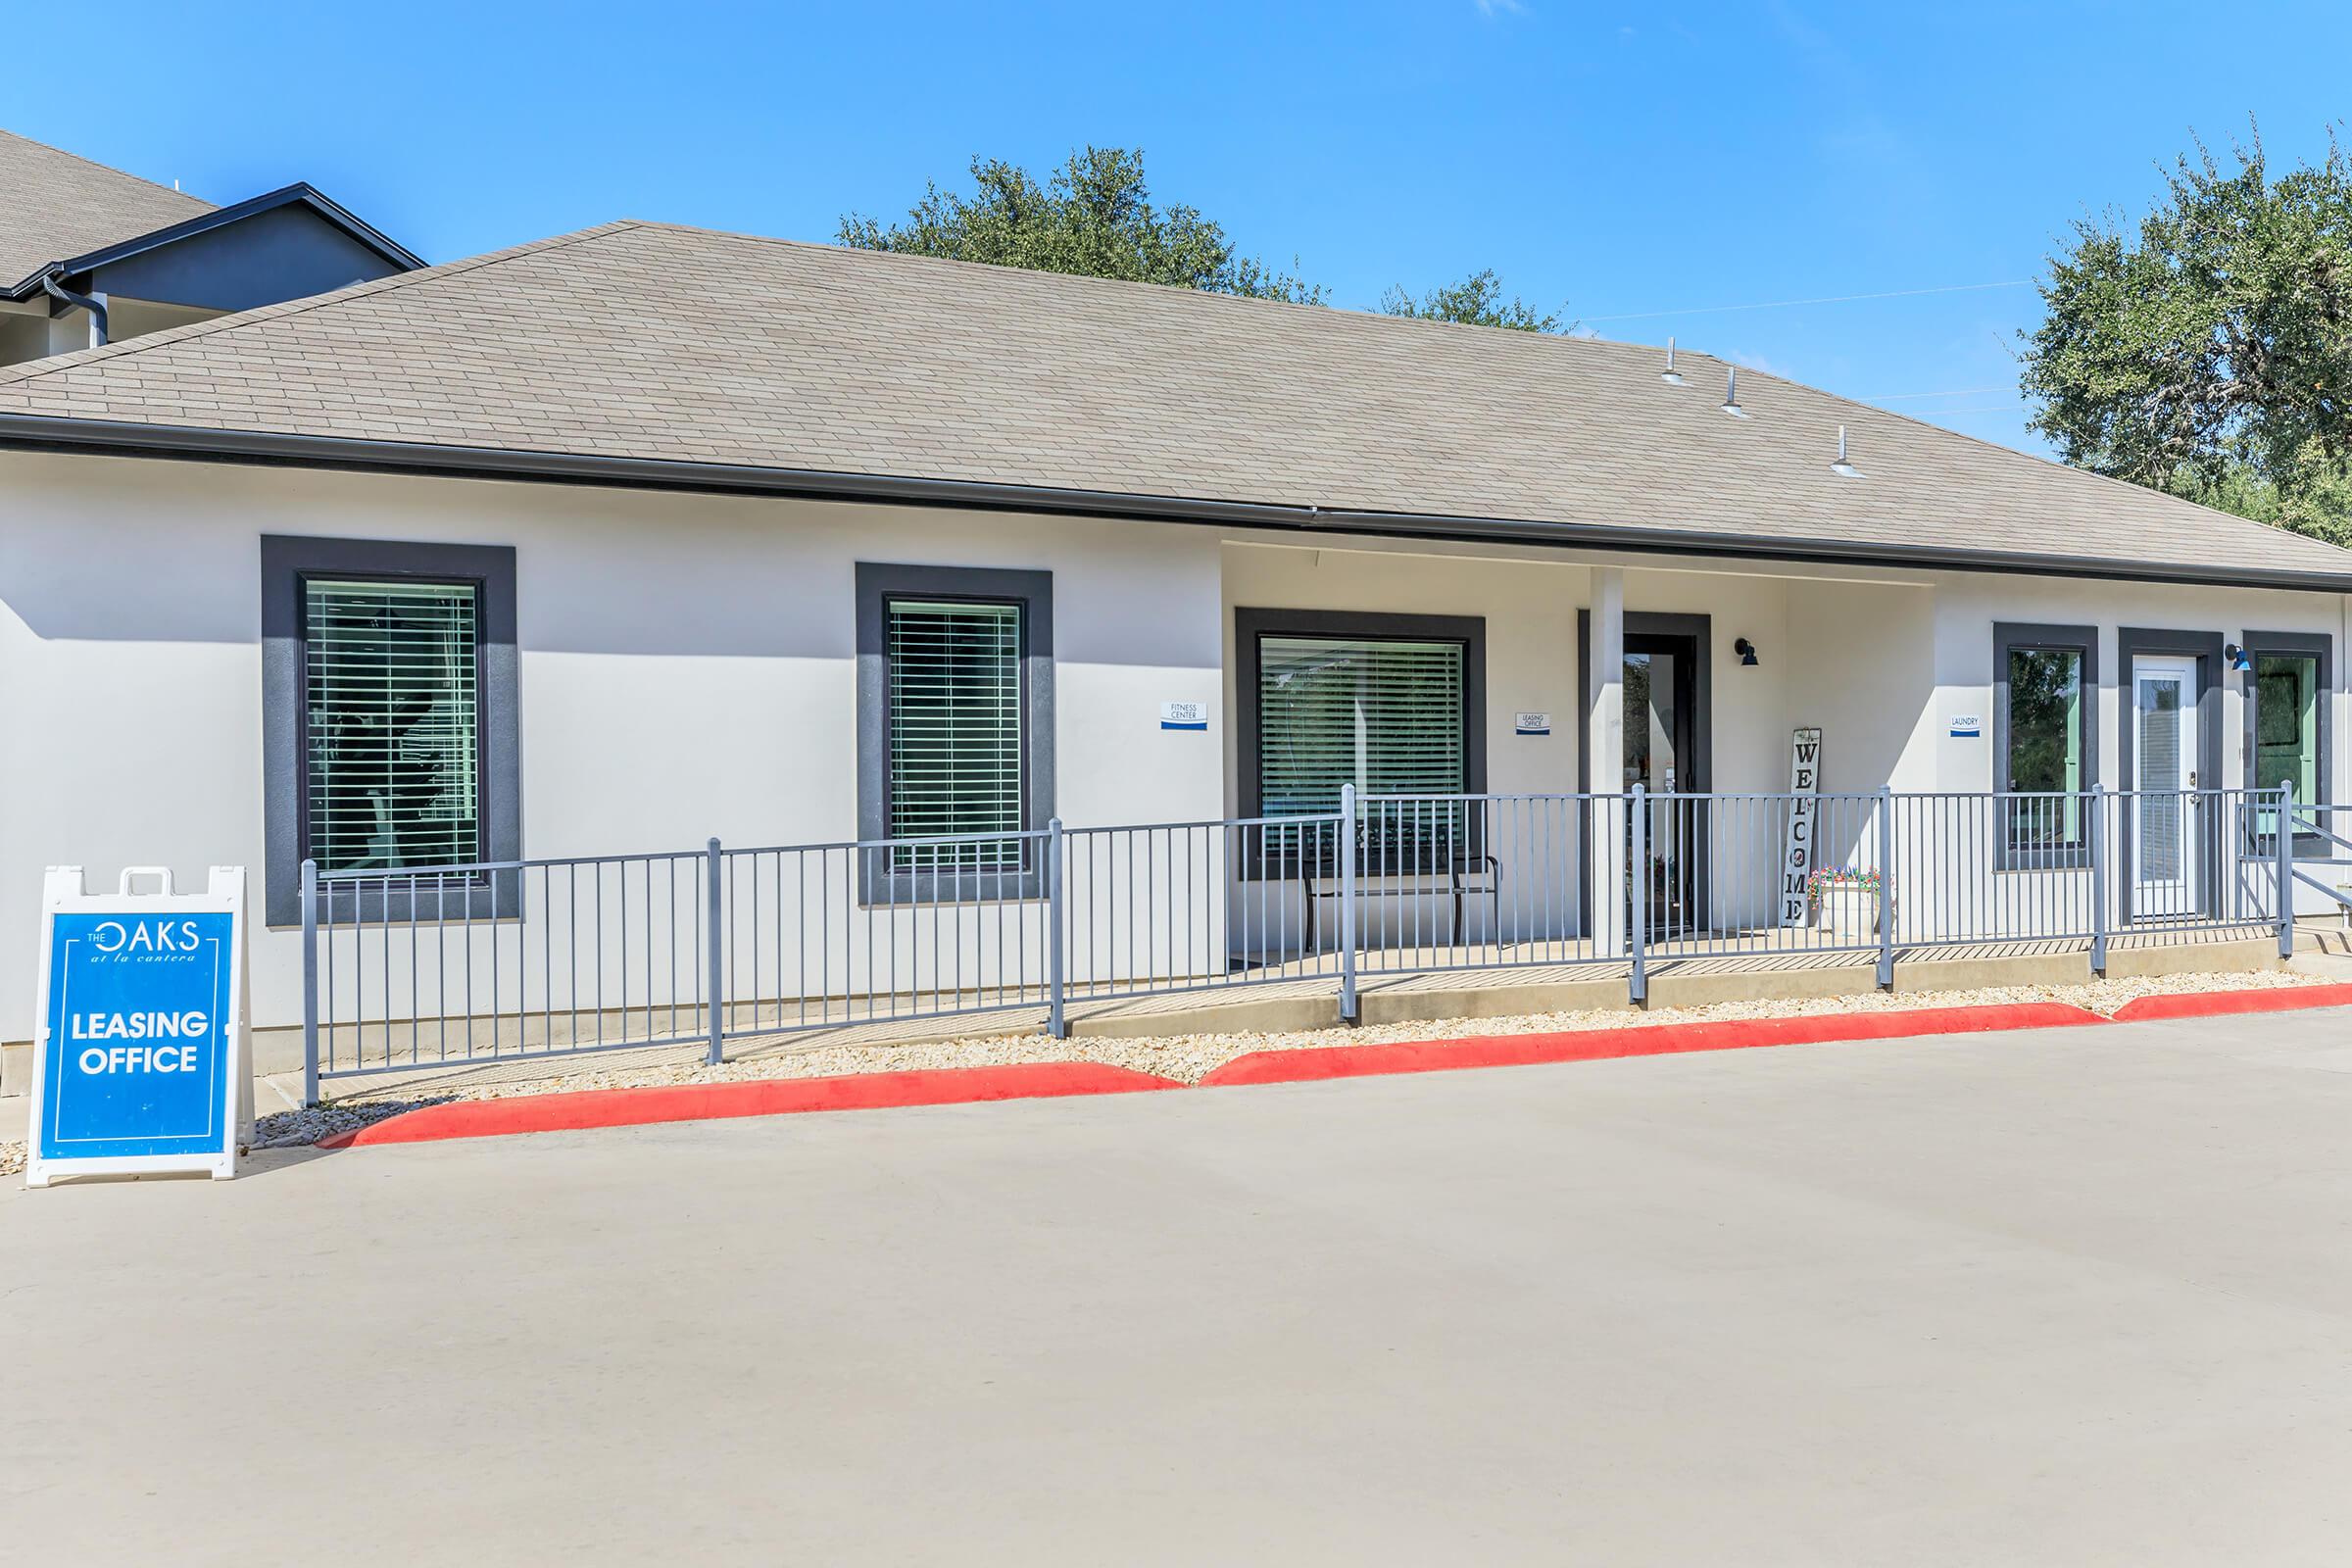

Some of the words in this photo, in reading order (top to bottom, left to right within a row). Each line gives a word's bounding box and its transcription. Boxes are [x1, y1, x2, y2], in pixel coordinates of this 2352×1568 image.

[1786, 743, 1818, 920] WELCOME
[87, 933, 106, 943] THE
[95, 920, 200, 952] OAKS
[90, 955, 108, 963] at
[114, 952, 129, 963] la
[136, 954, 196, 963] cantera
[72, 1010, 209, 1040] LEASING
[78, 1046, 198, 1075] OFFICE
